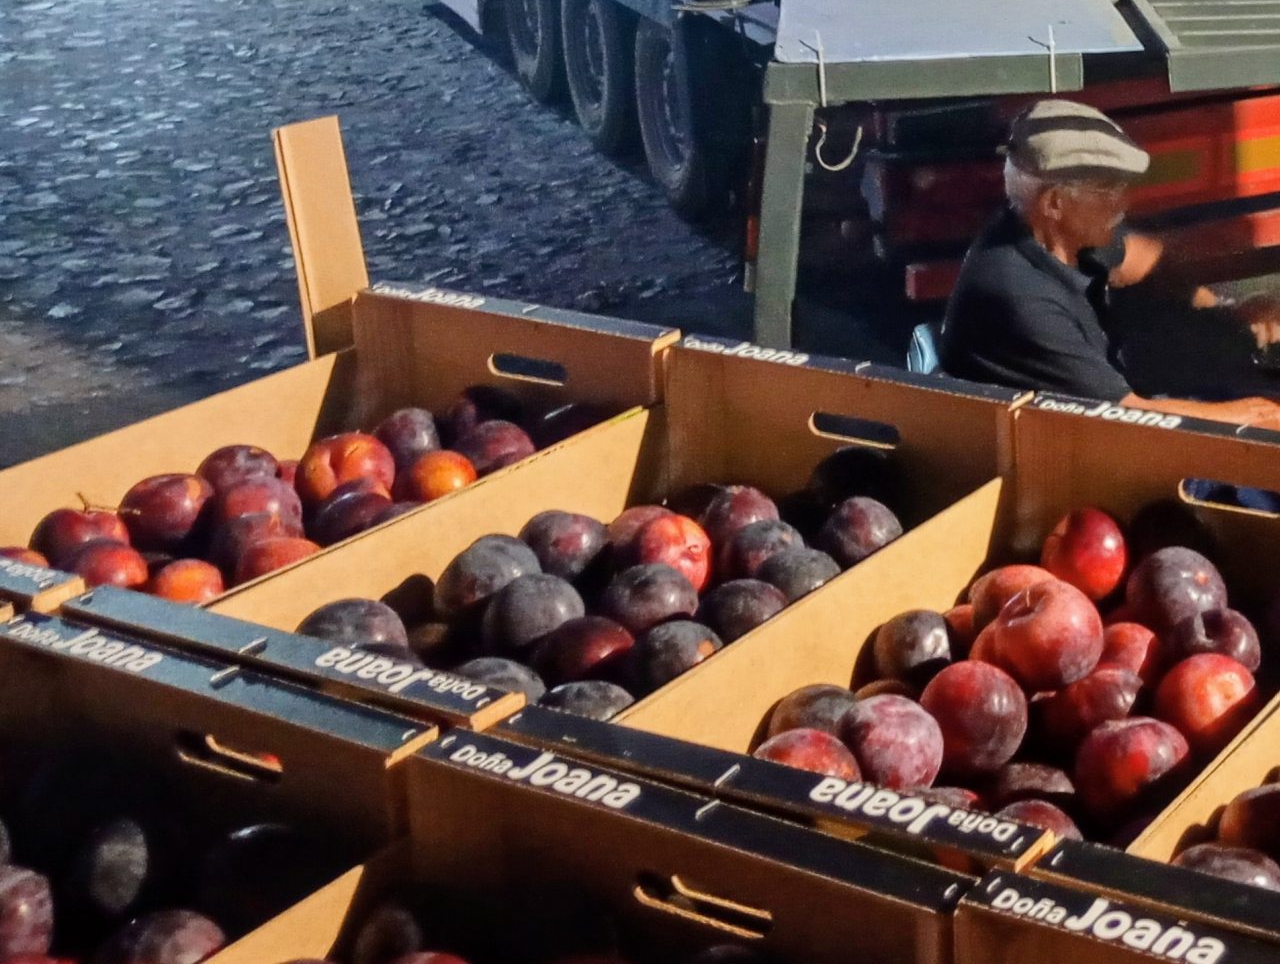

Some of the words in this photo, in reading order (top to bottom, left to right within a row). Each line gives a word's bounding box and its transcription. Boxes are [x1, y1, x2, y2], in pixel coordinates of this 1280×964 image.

[722, 341, 809, 366] Joana
[1039, 399, 1085, 415] Doña
[1084, 400, 1182, 429] Joana
[51, 627, 164, 672] Joana
[315, 647, 433, 693] Joana
[428, 674, 487, 701] Doña
[450, 744, 513, 774] Doña
[506, 751, 641, 808] Joana
[809, 777, 951, 834] Joana
[947, 809, 1018, 842] Doña
[991, 888, 1067, 924] Doña
[1064, 898, 1226, 964] Joana
